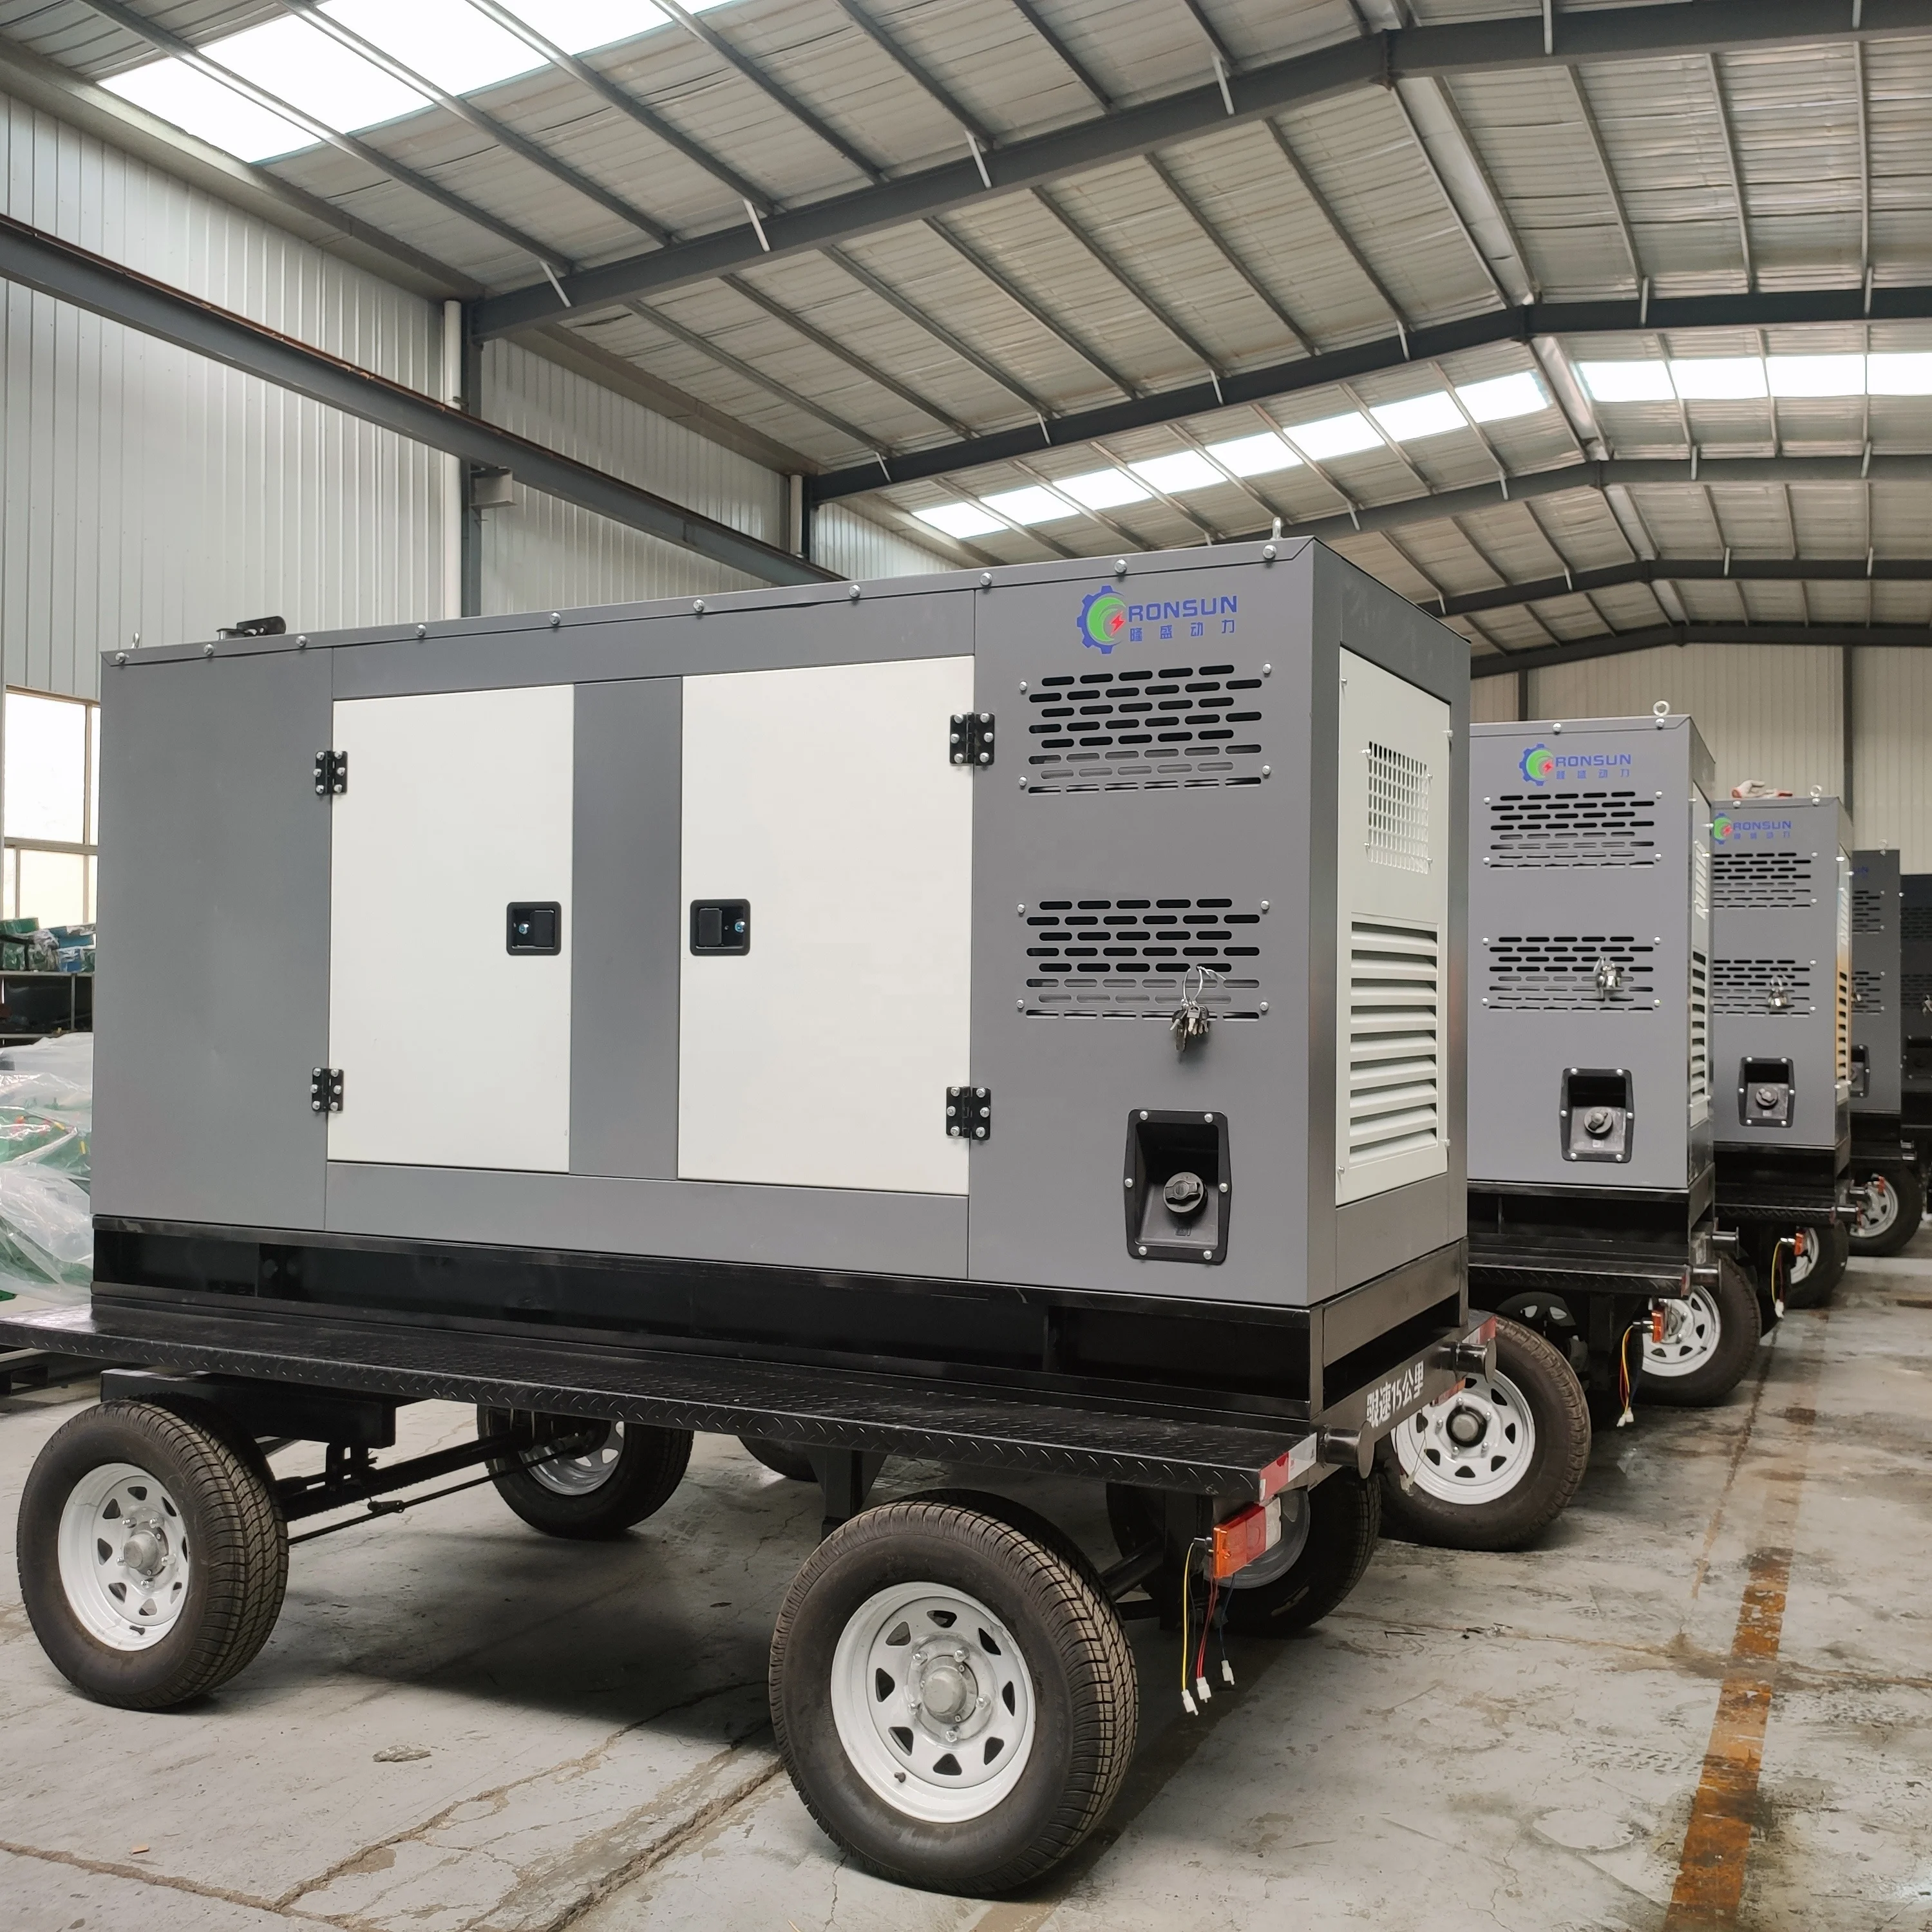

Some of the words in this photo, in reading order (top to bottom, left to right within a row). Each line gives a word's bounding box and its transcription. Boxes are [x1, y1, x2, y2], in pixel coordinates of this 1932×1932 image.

[1128, 595, 1237, 623] RONSUN
[1555, 753, 1631, 768] RONSUN
[1733, 820, 1792, 830] RONSUN
[1366, 1359, 1425, 1428] 限速15公里
